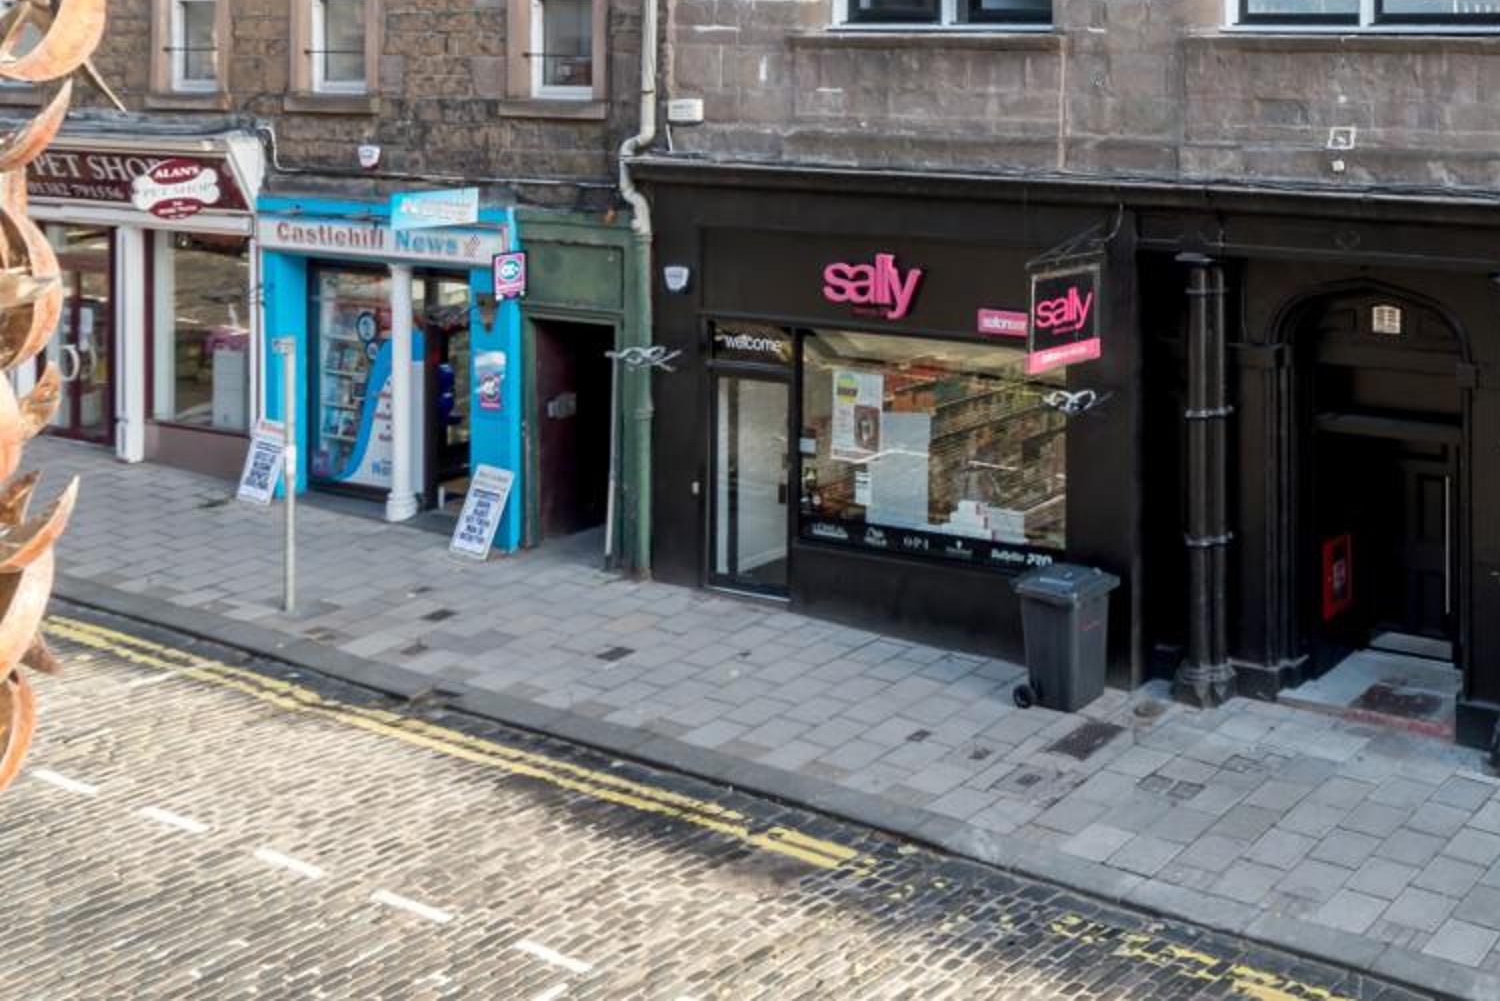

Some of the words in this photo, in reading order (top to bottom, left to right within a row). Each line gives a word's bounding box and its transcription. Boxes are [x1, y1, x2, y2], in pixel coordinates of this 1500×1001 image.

[32, 153, 80, 178] PET
[277, 222, 384, 248] Castlehill
[395, 230, 459, 254] News
[823, 253, 922, 319] sally
[1036, 286, 1093, 330] sally
[726, 333, 782, 352] welcome
